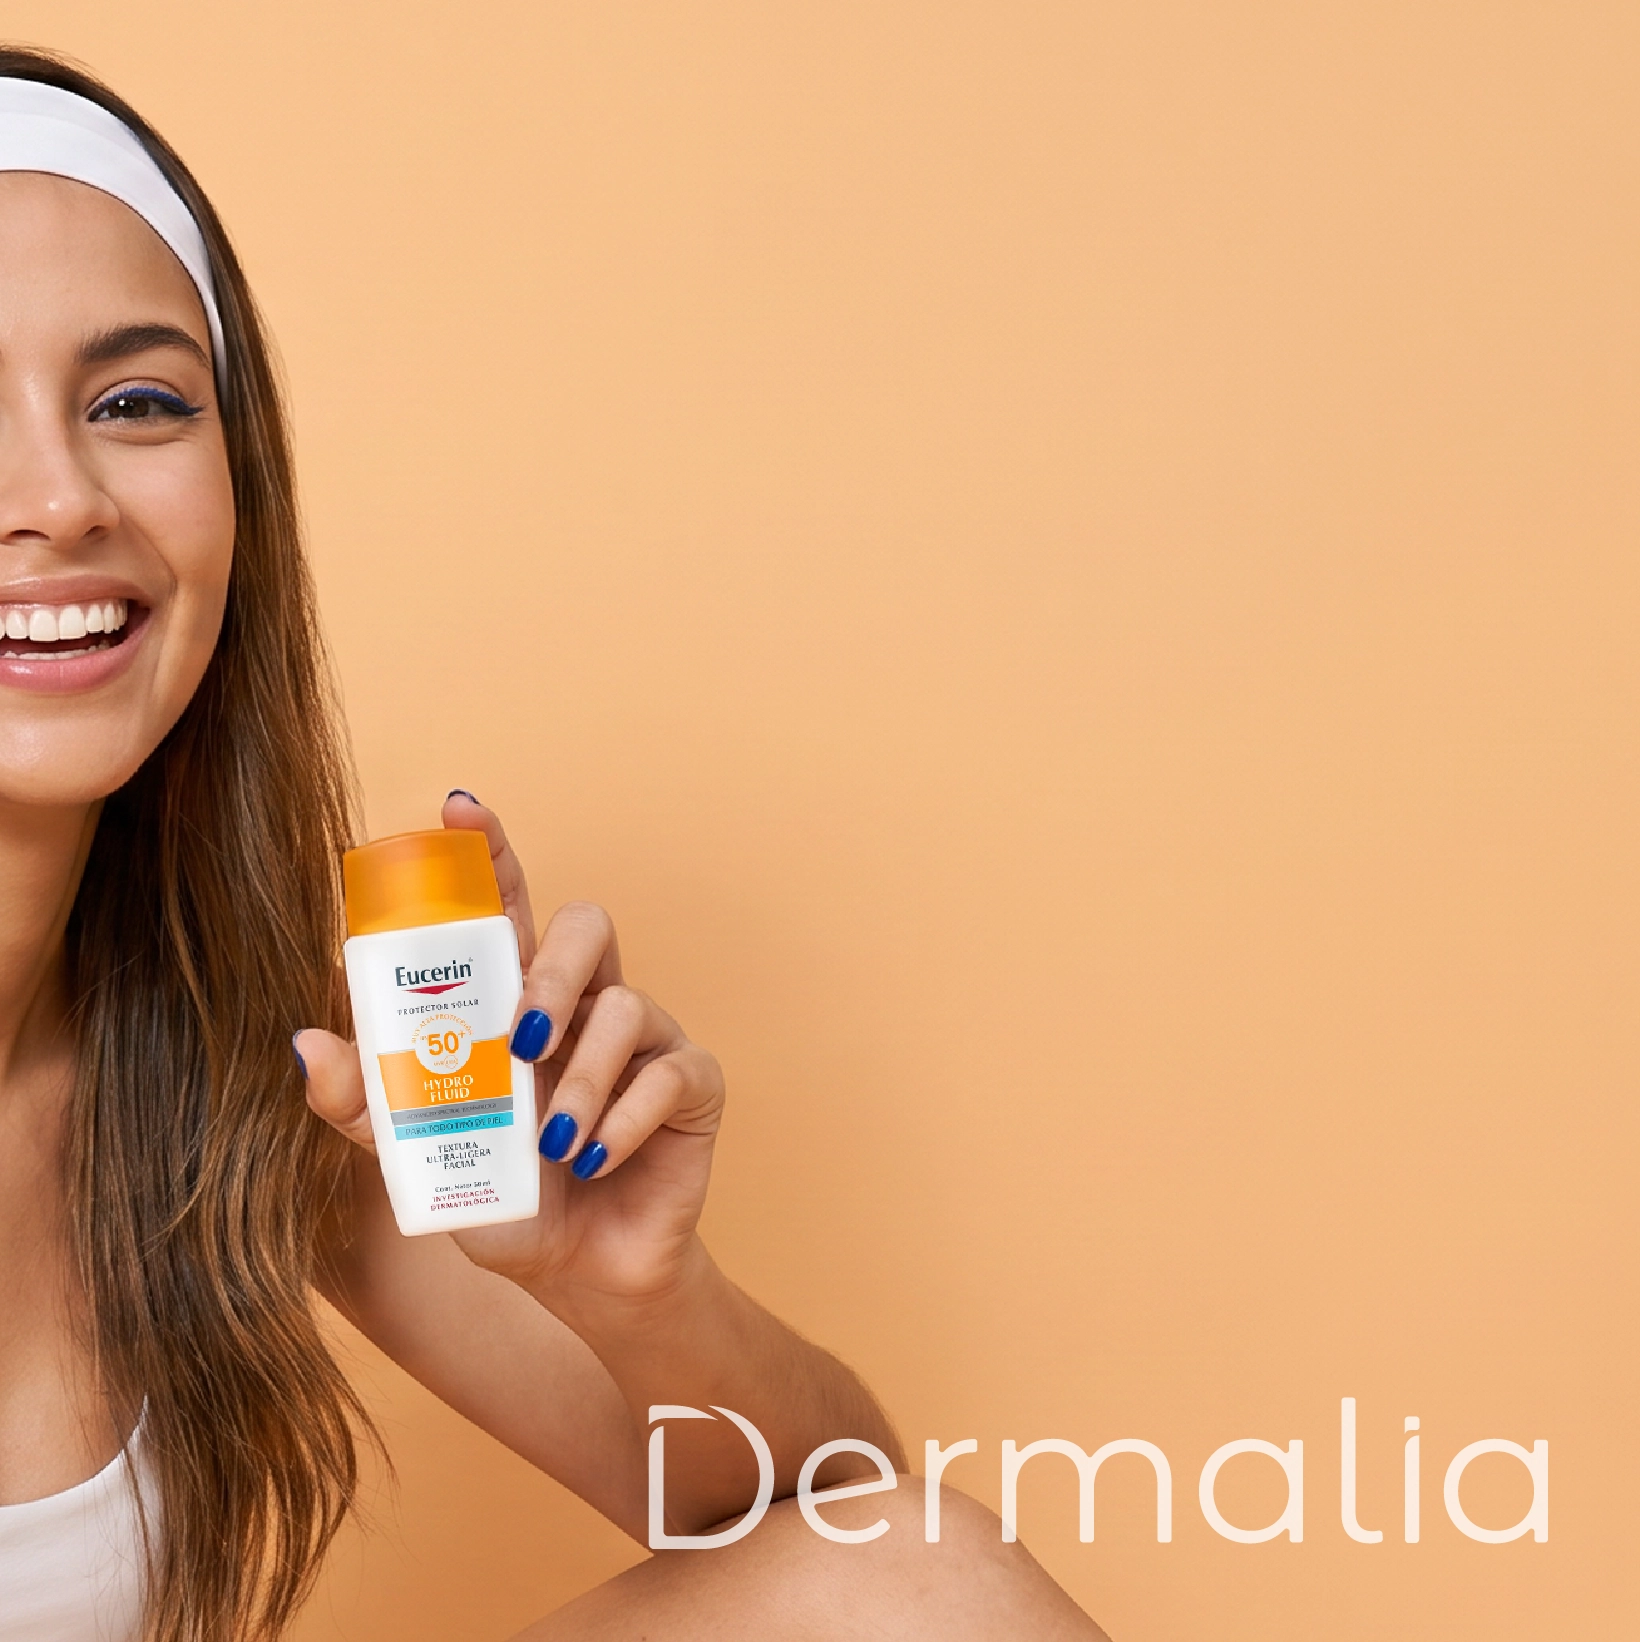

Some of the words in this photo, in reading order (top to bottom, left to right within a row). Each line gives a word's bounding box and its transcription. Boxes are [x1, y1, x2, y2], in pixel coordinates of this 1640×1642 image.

[395, 959, 472, 987] Eucerin
[397, 1003, 449, 1016] PROTECTOR
[424, 1074, 474, 1091] HYDRO
[430, 1087, 470, 1103] FLUID
[405, 1126, 427, 1136] PARA
[487, 1116, 503, 1125] PIEL
[438, 1141, 479, 1154] TEXTURA
[426, 1148, 491, 1164] ULTRA-LIGERA
[444, 1158, 476, 1170] FACIAL
